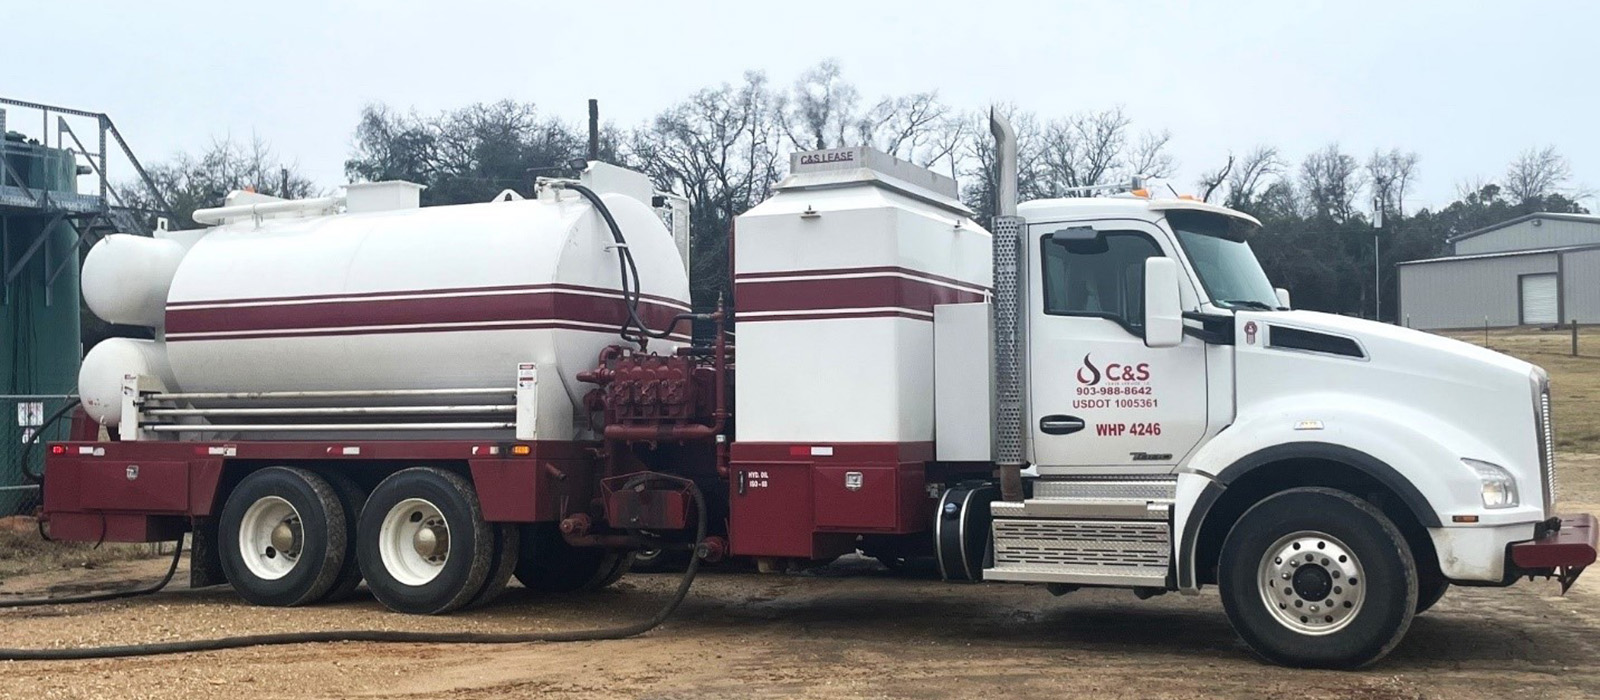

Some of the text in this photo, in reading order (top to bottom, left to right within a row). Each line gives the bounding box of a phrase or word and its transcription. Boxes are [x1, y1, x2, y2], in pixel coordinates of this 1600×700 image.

[801, 151, 853, 164] C&S LEASE
[1105, 363, 1150, 381] C&S
[1076, 386, 1152, 396] 903-988-8642
[1072, 399, 1158, 409] USDOT 1005361
[1096, 423, 1161, 436] WHP 4246
